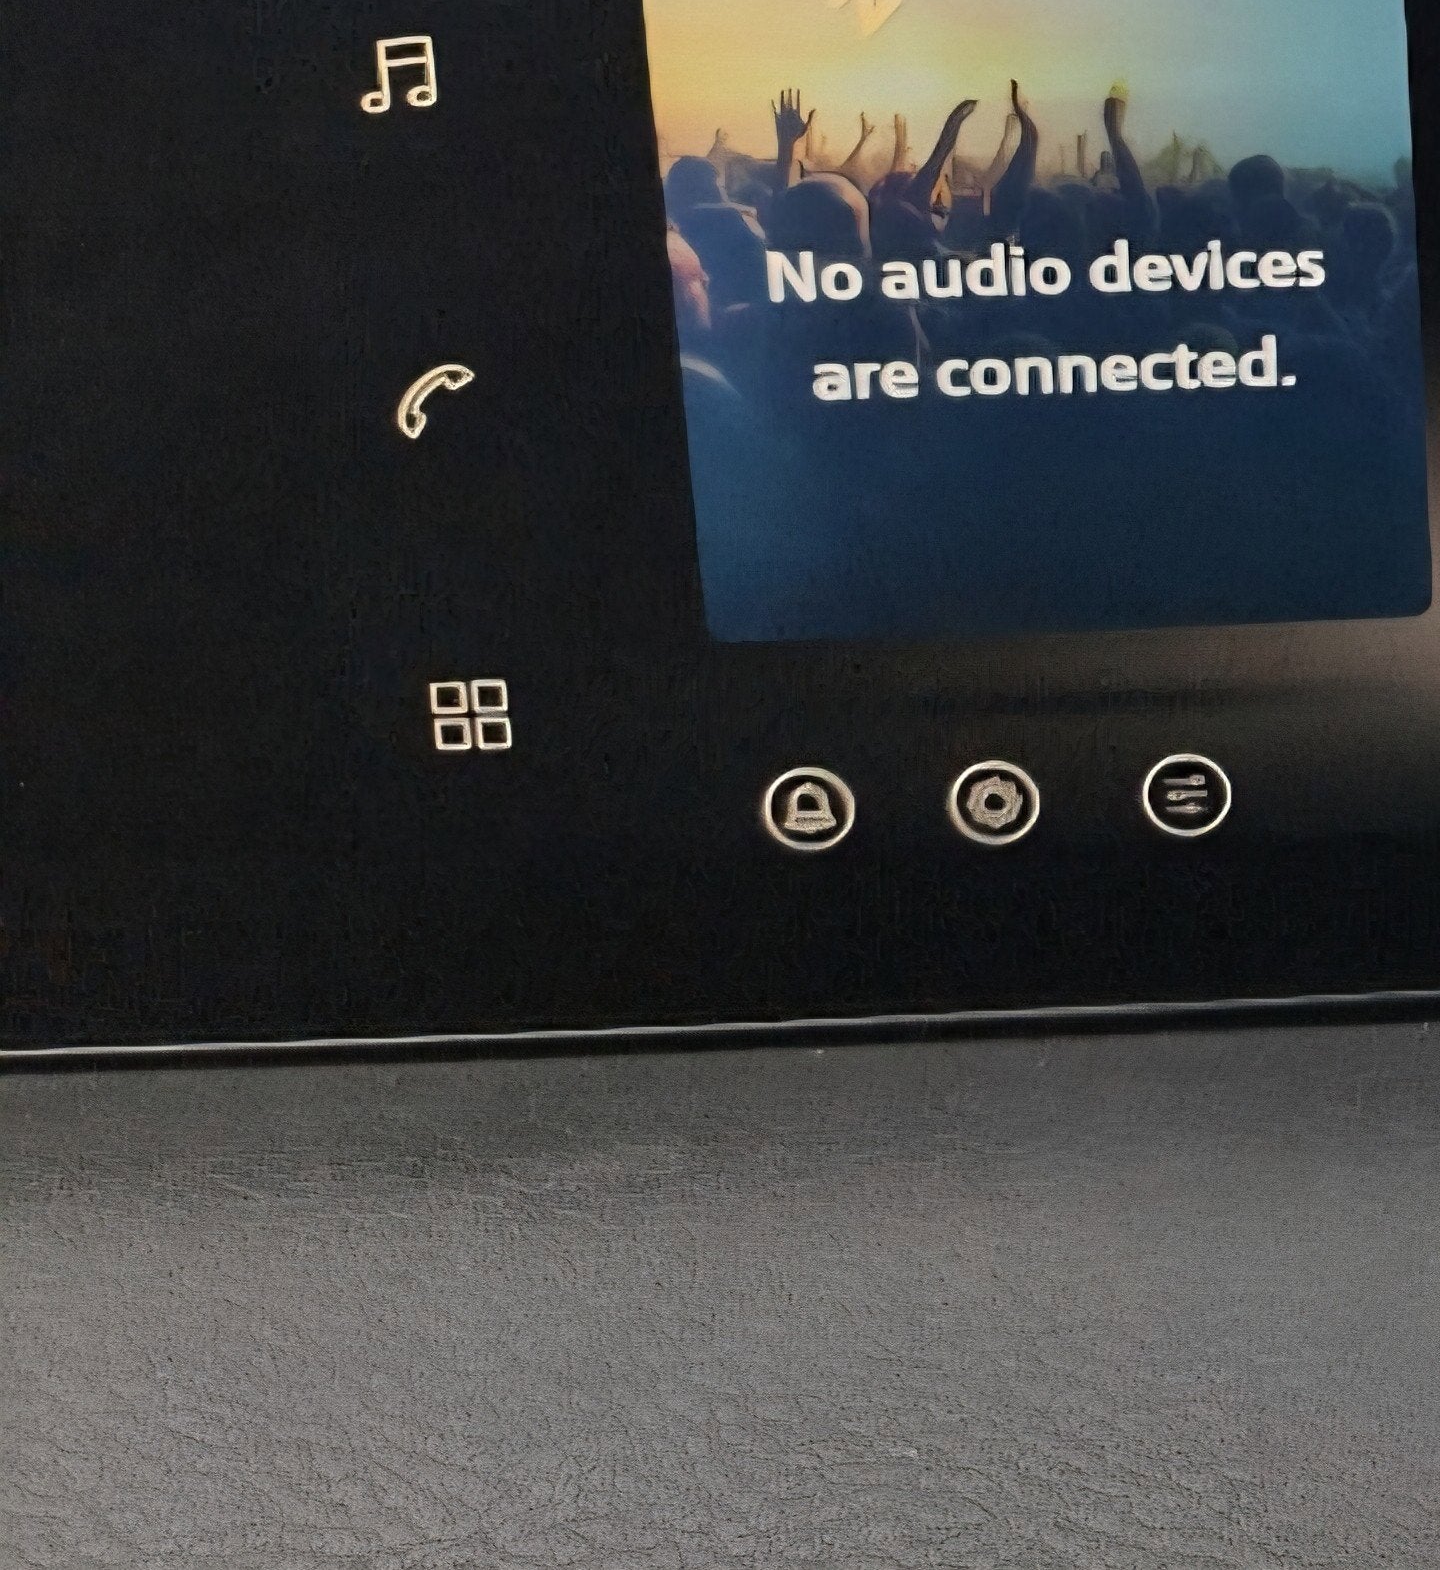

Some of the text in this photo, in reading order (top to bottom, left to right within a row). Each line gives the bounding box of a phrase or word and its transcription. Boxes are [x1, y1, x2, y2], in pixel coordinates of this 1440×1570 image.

[766, 240, 1325, 303] No audio devices
[812, 336, 1296, 400] are connected.
